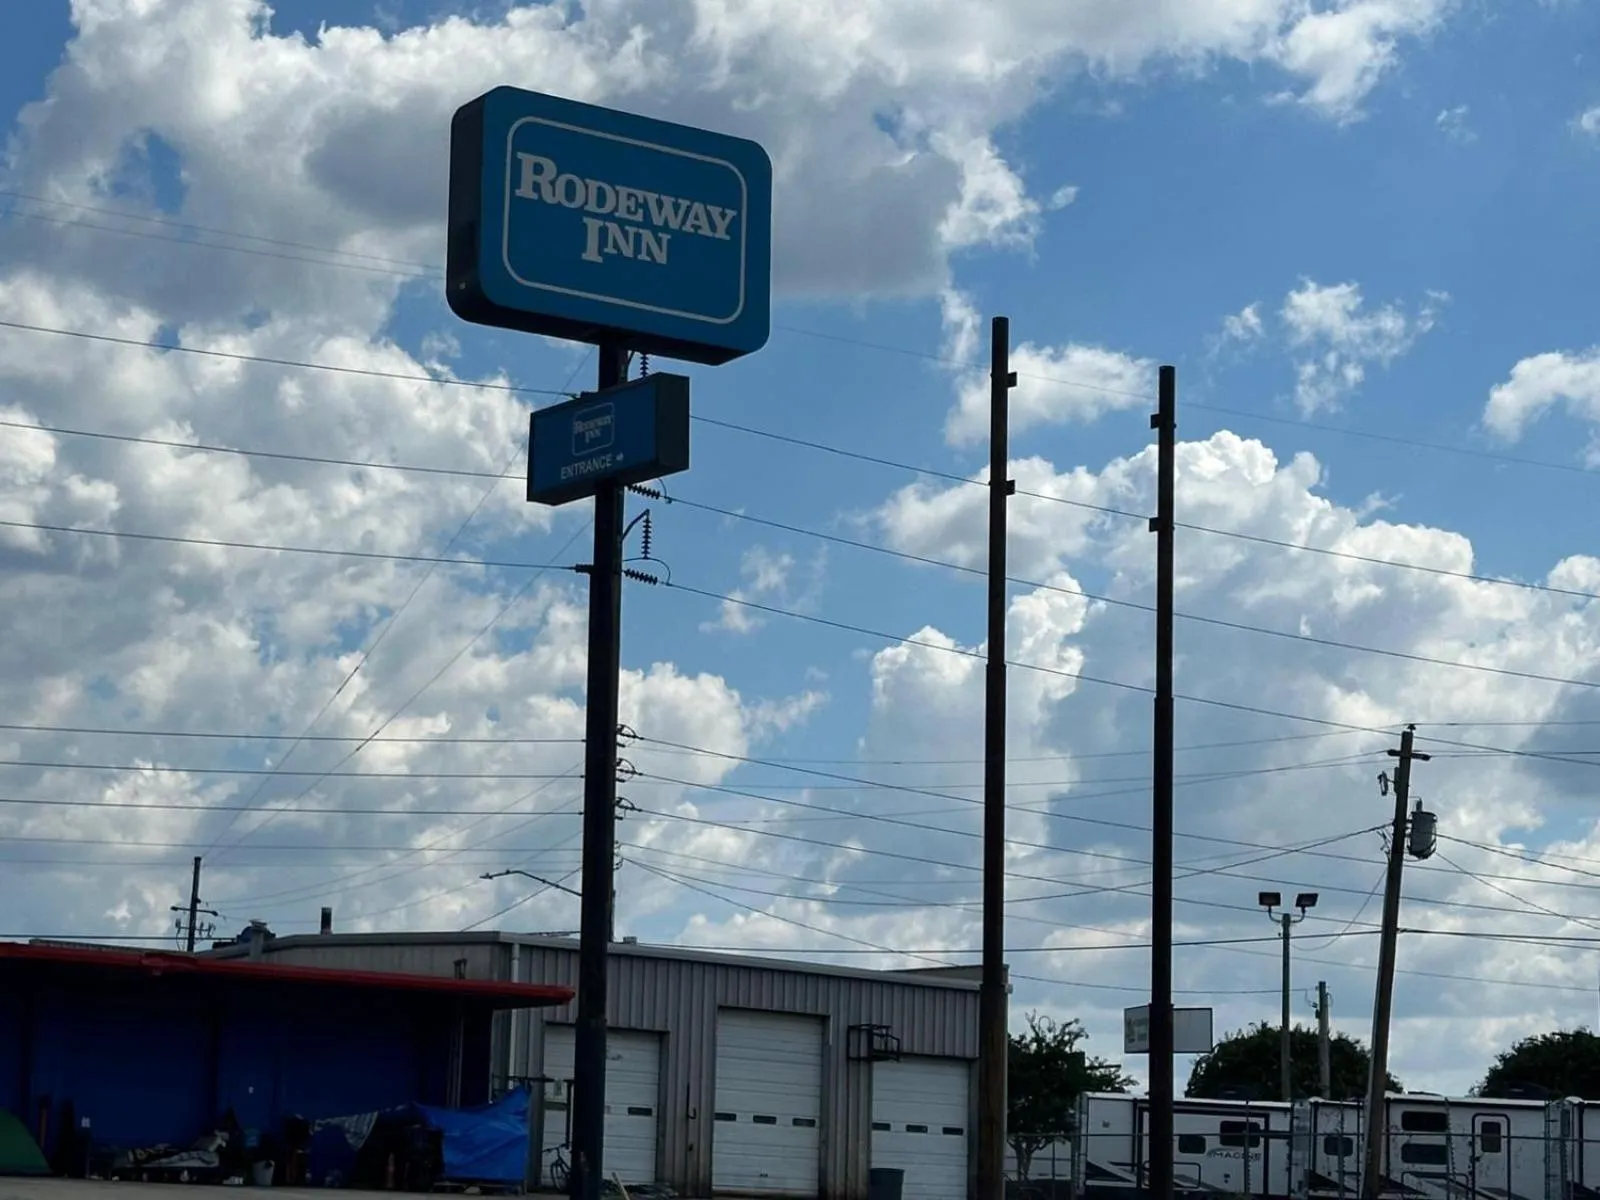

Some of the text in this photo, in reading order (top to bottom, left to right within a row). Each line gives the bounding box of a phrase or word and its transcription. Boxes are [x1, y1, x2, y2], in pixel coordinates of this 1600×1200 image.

[515, 152, 737, 240] RODEWAY
[582, 217, 671, 264] INN
[560, 454, 613, 479] ENTRANCE
